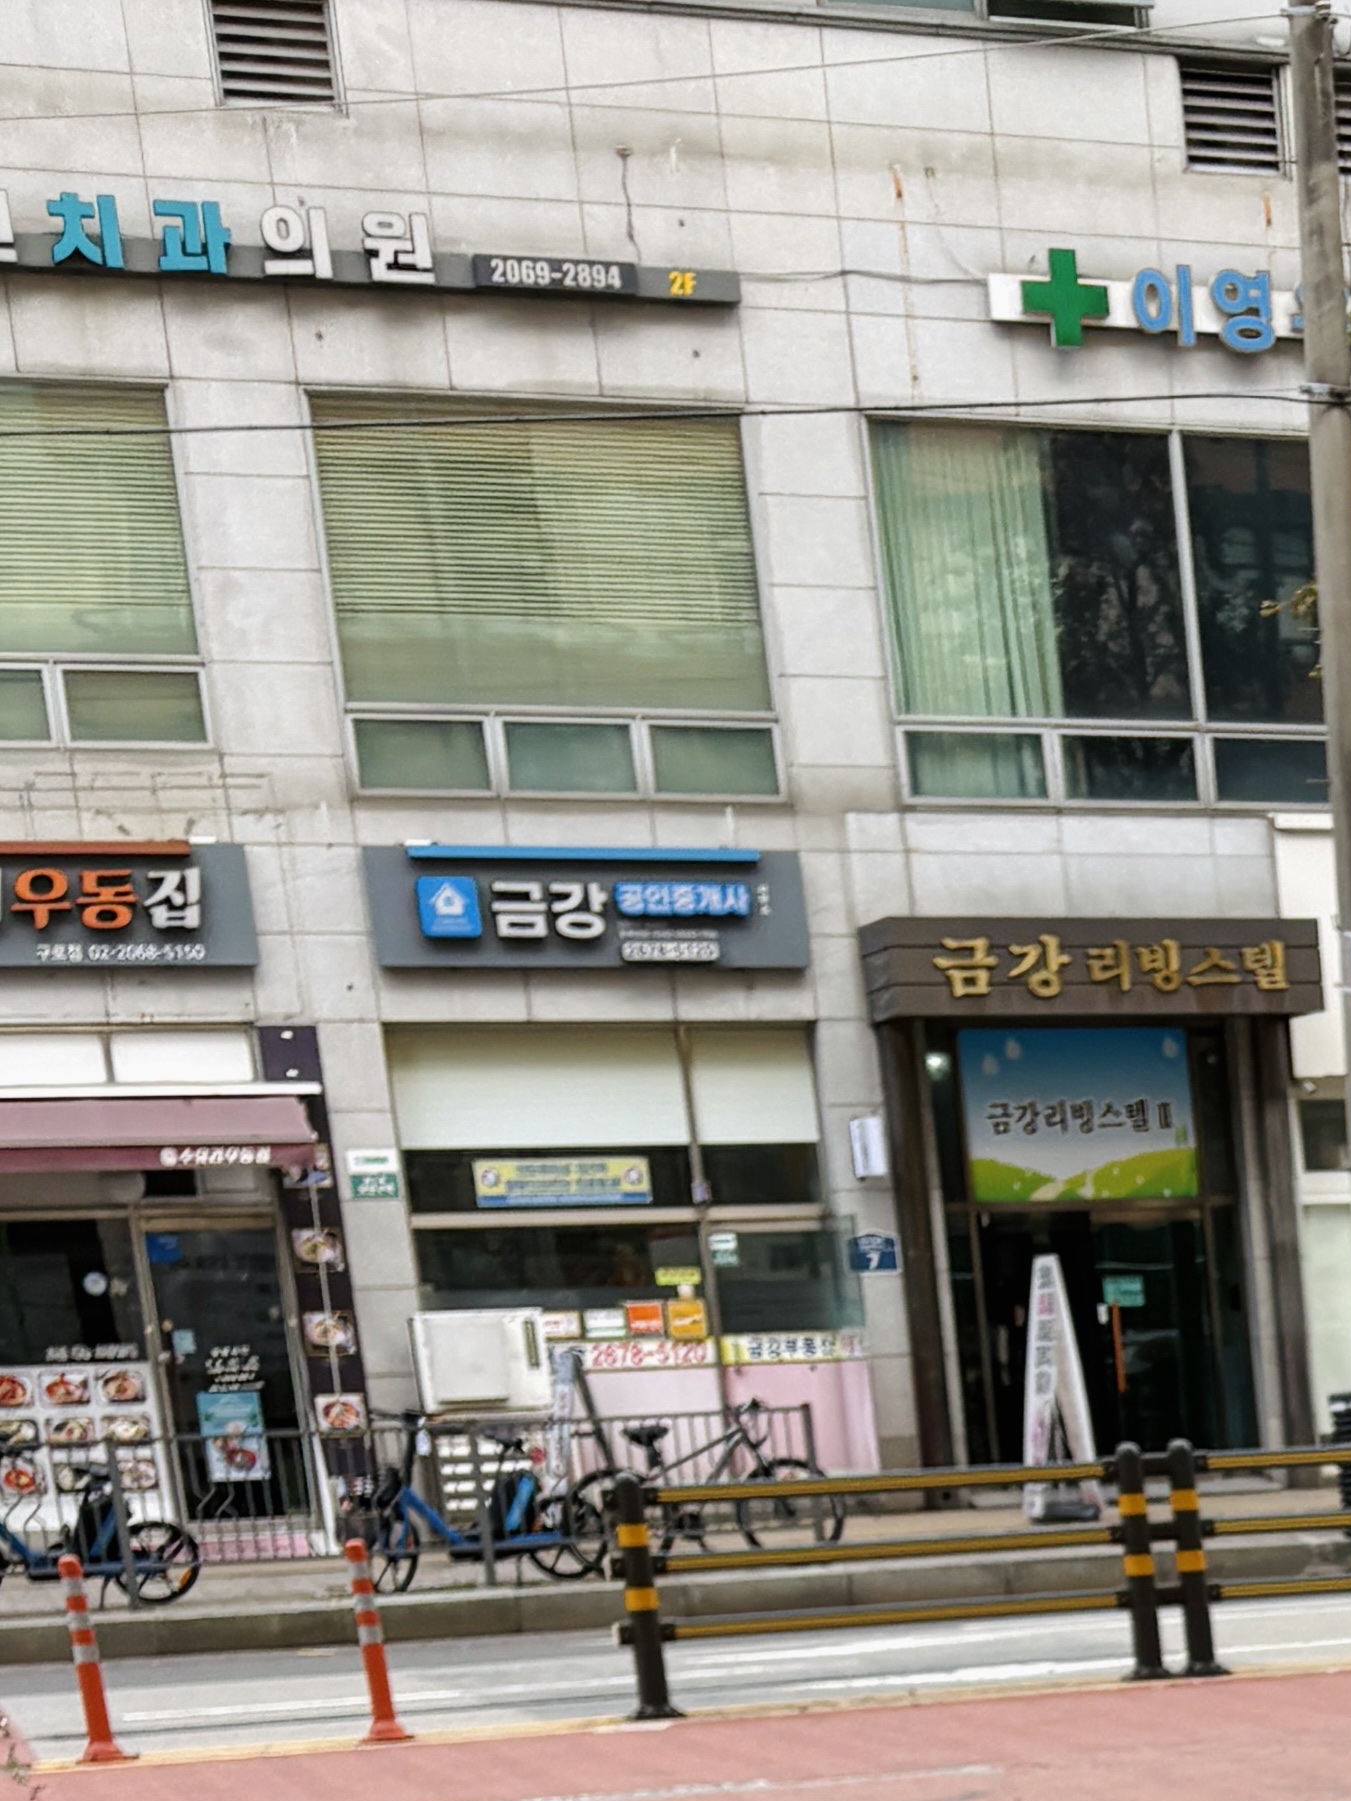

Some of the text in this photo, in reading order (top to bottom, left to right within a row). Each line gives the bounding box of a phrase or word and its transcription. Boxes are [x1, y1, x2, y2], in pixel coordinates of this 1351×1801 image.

[0, 190, 696, 296] 치과의원 2069-2894 2F
[491, 882, 609, 940] 금강
[932, 934, 1290, 998] 금강 리빙스텔
[987, 1098, 1149, 1135] 금강리빙스텔
